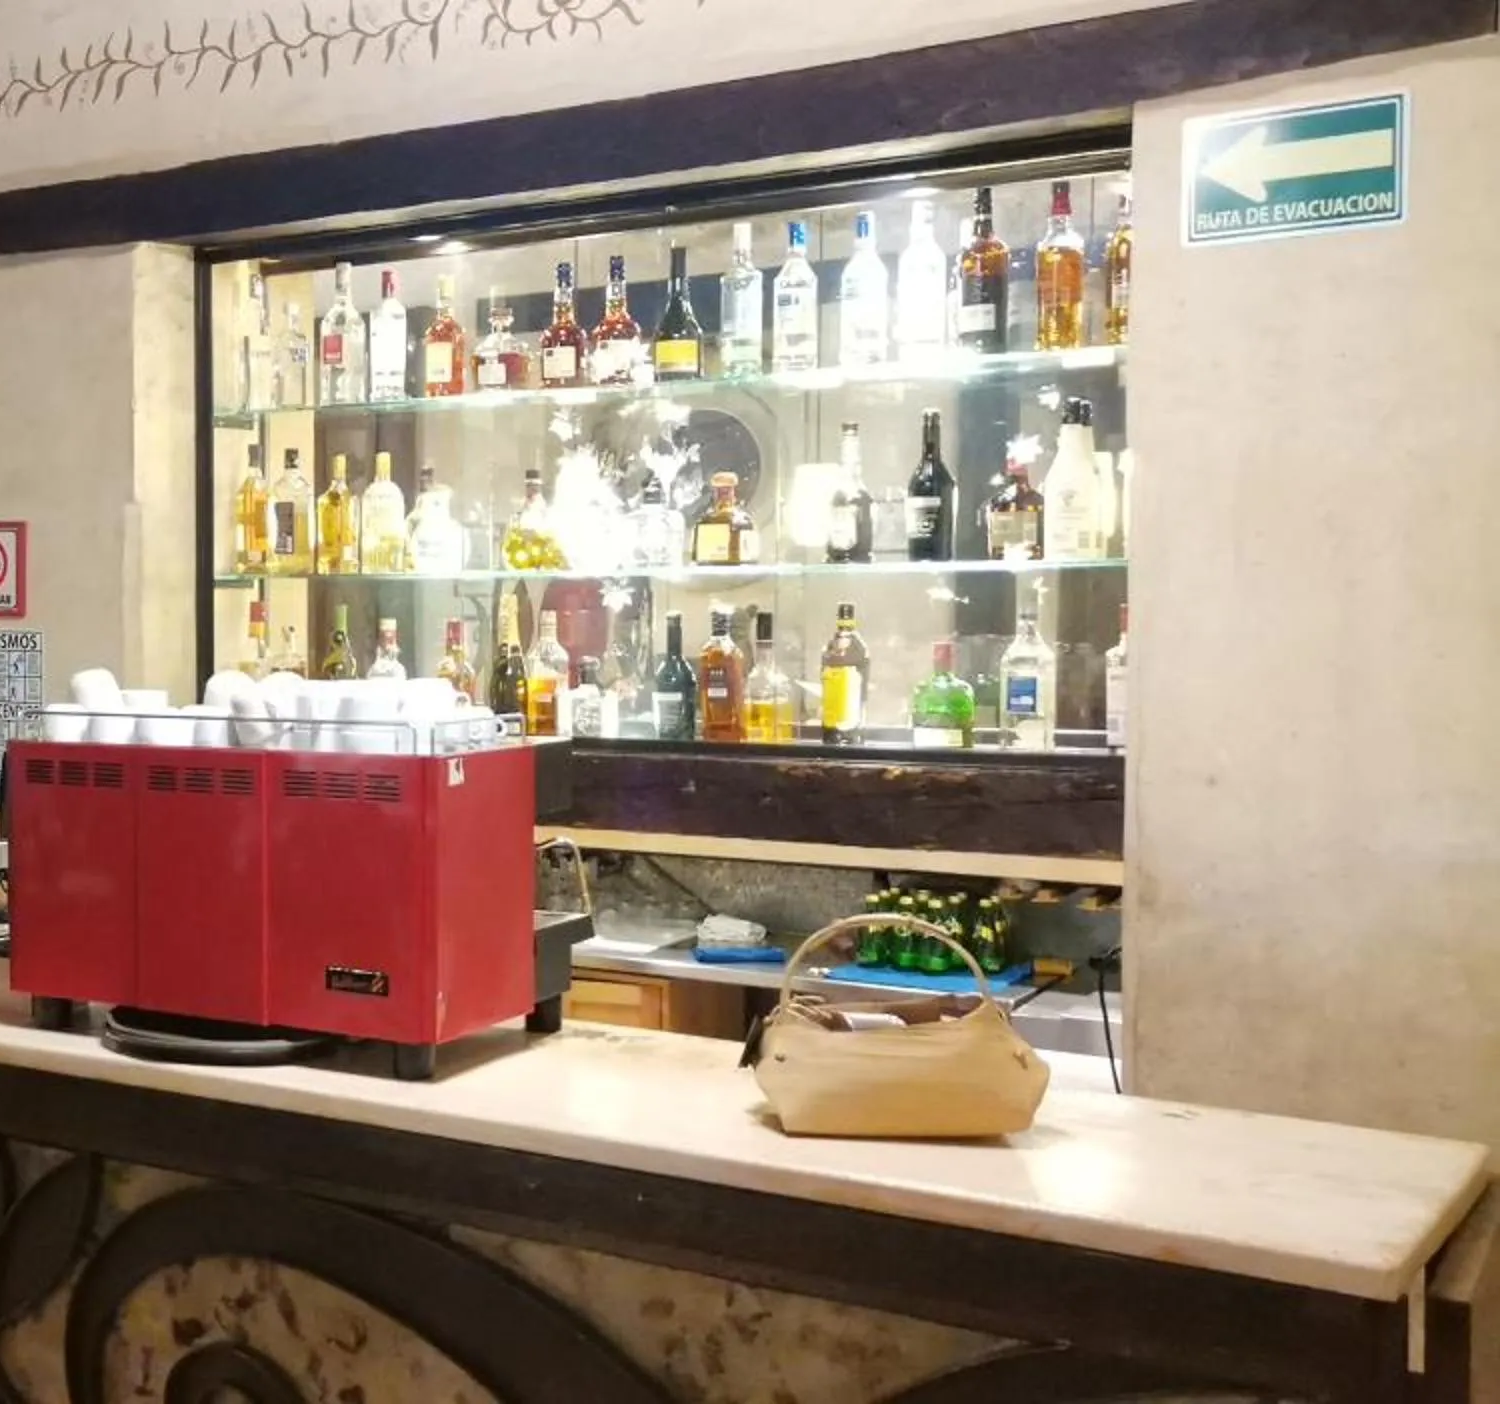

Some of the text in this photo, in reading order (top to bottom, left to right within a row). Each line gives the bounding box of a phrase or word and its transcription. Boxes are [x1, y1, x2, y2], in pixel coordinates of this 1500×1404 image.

[1196, 191, 1394, 231] RUTA DE EVACUACION
